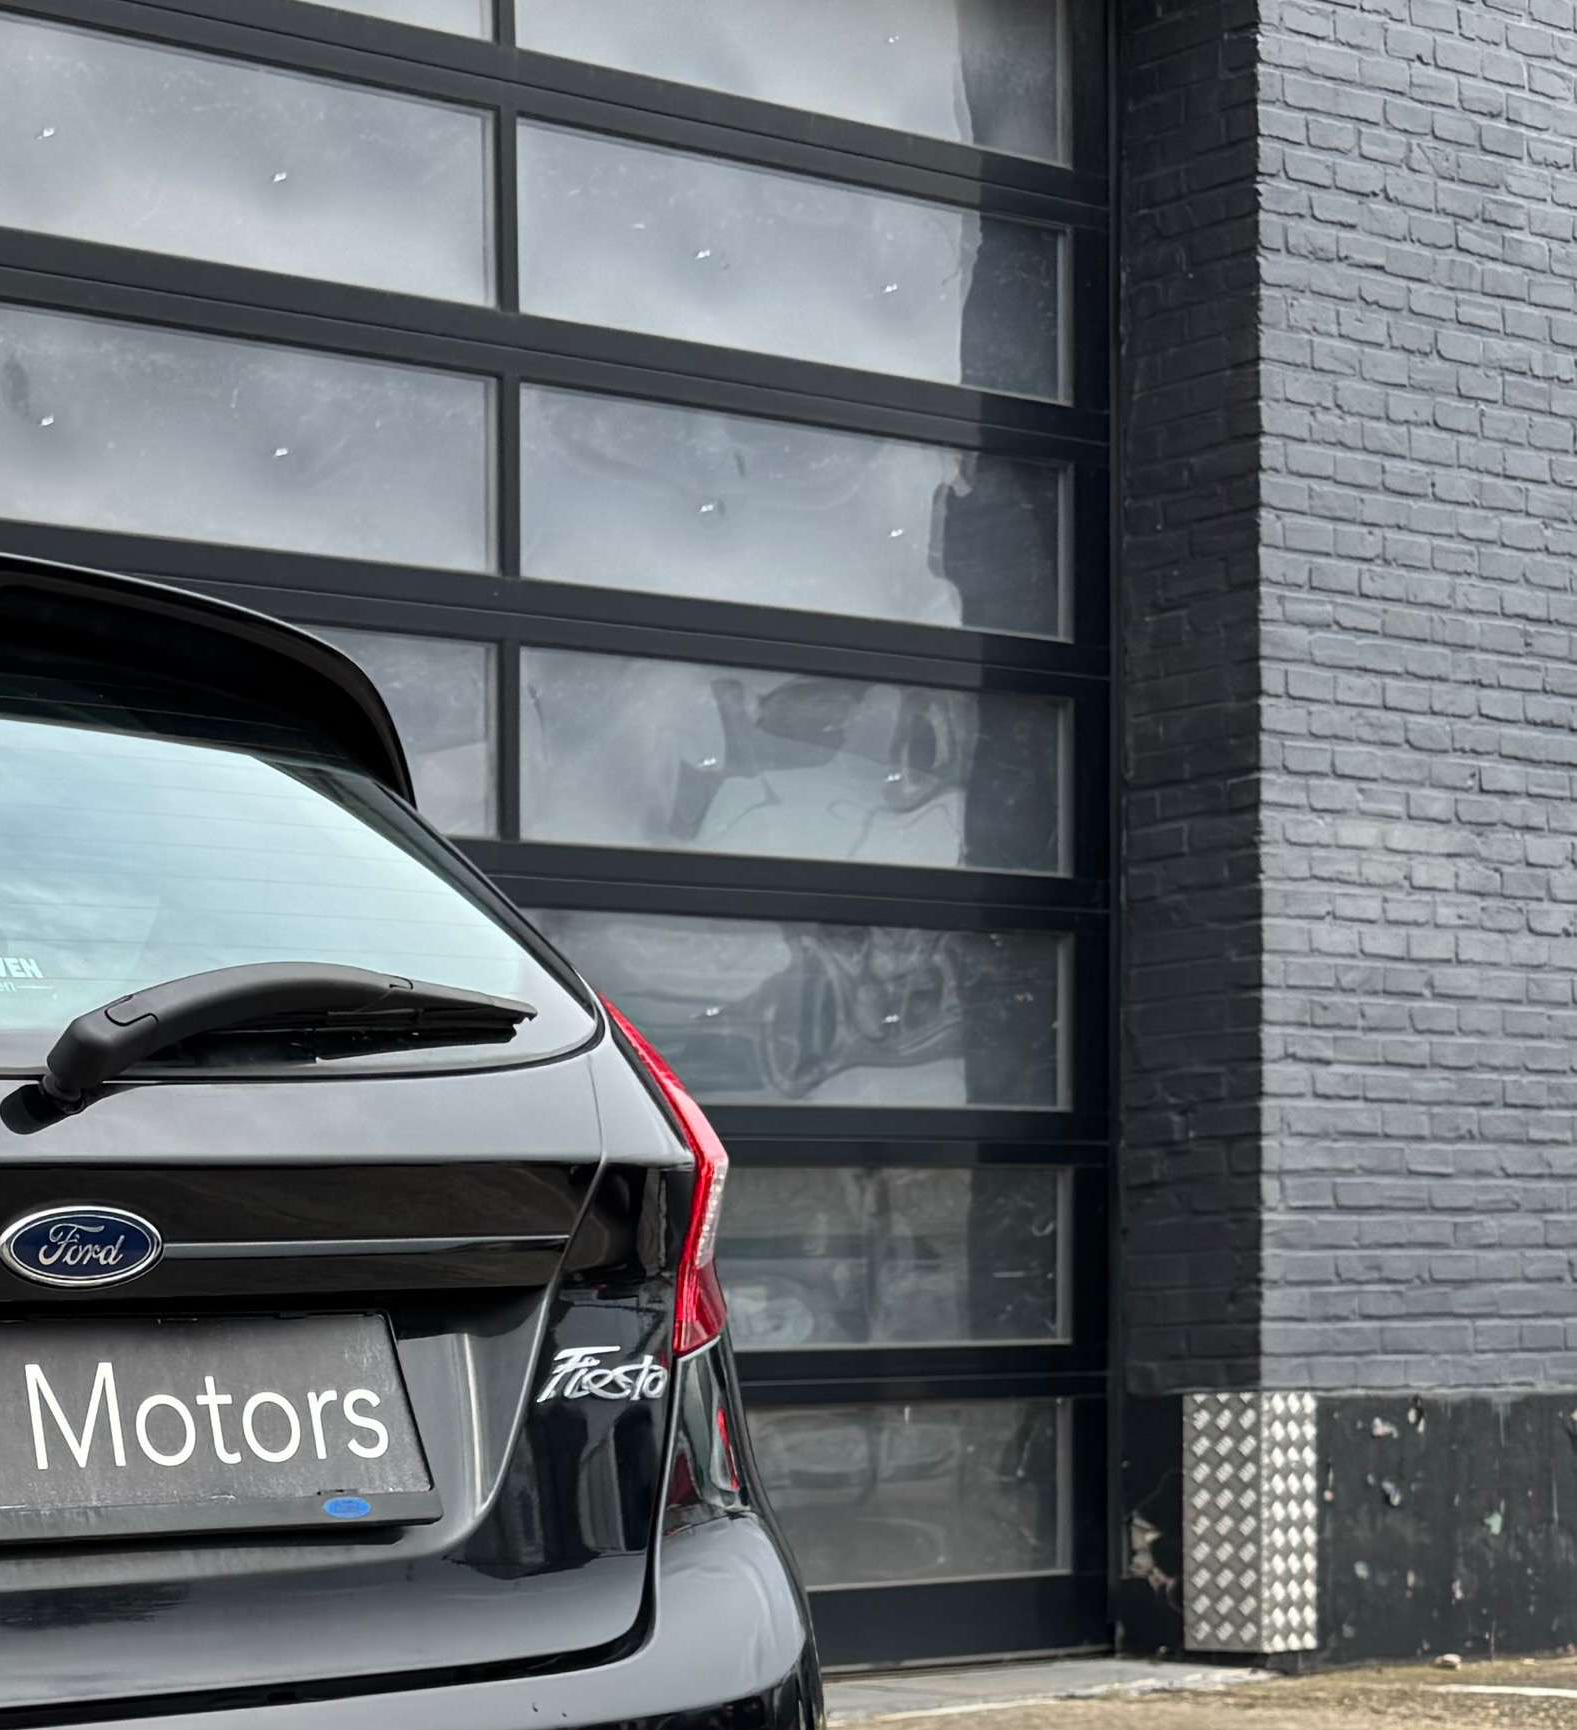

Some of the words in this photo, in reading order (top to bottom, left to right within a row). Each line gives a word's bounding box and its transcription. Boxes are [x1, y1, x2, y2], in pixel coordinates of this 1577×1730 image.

[38, 1223, 125, 1266] Ford
[536, 1345, 668, 1403] Fiesta
[24, 1362, 389, 1470] Motors
